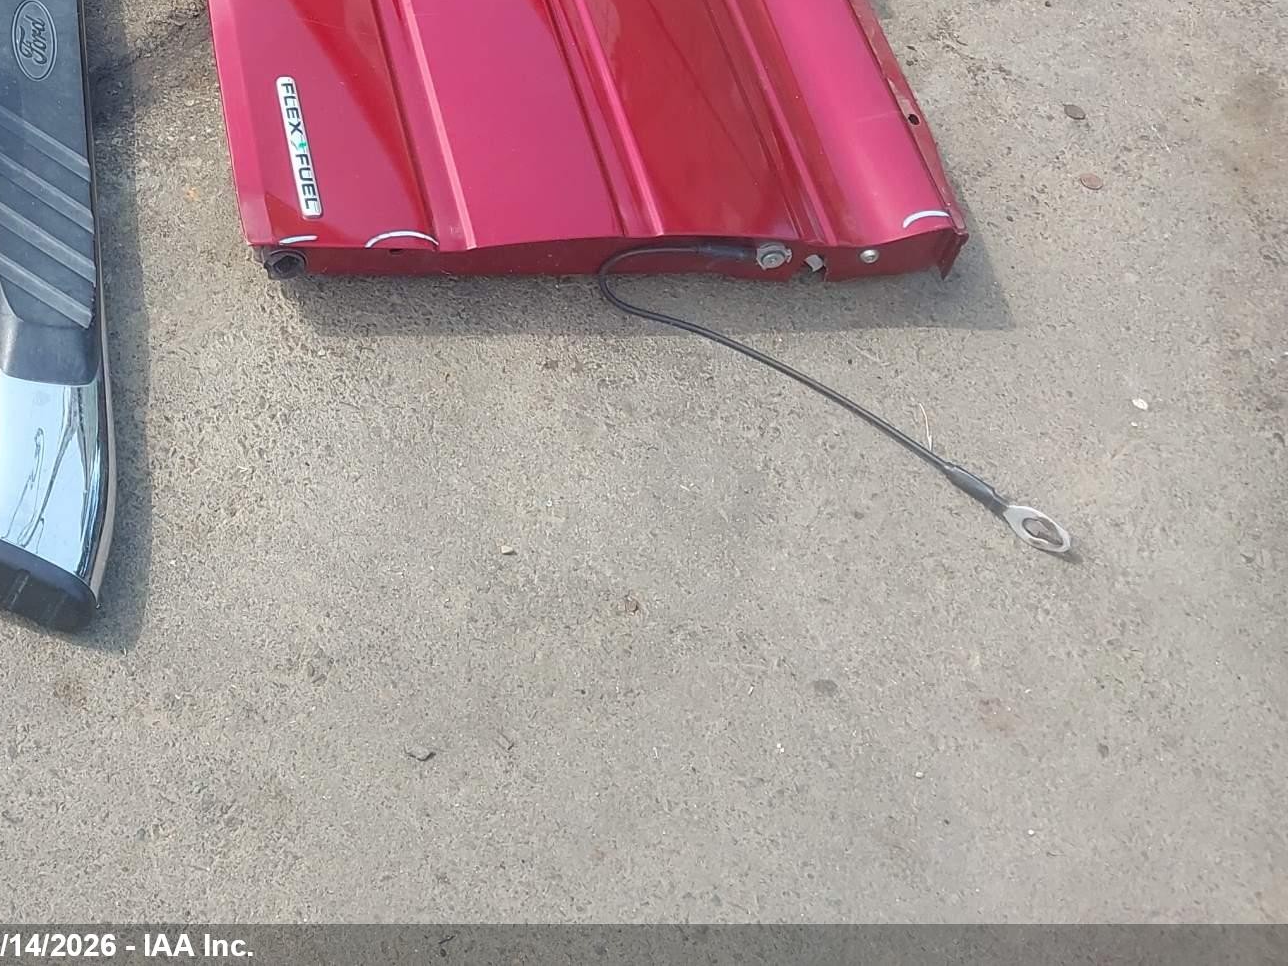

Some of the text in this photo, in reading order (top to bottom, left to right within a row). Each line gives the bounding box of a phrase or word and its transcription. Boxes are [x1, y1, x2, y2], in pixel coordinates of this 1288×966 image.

[19, 14, 47, 65] Ford
[280, 82, 318, 210] FLEX FUEL
